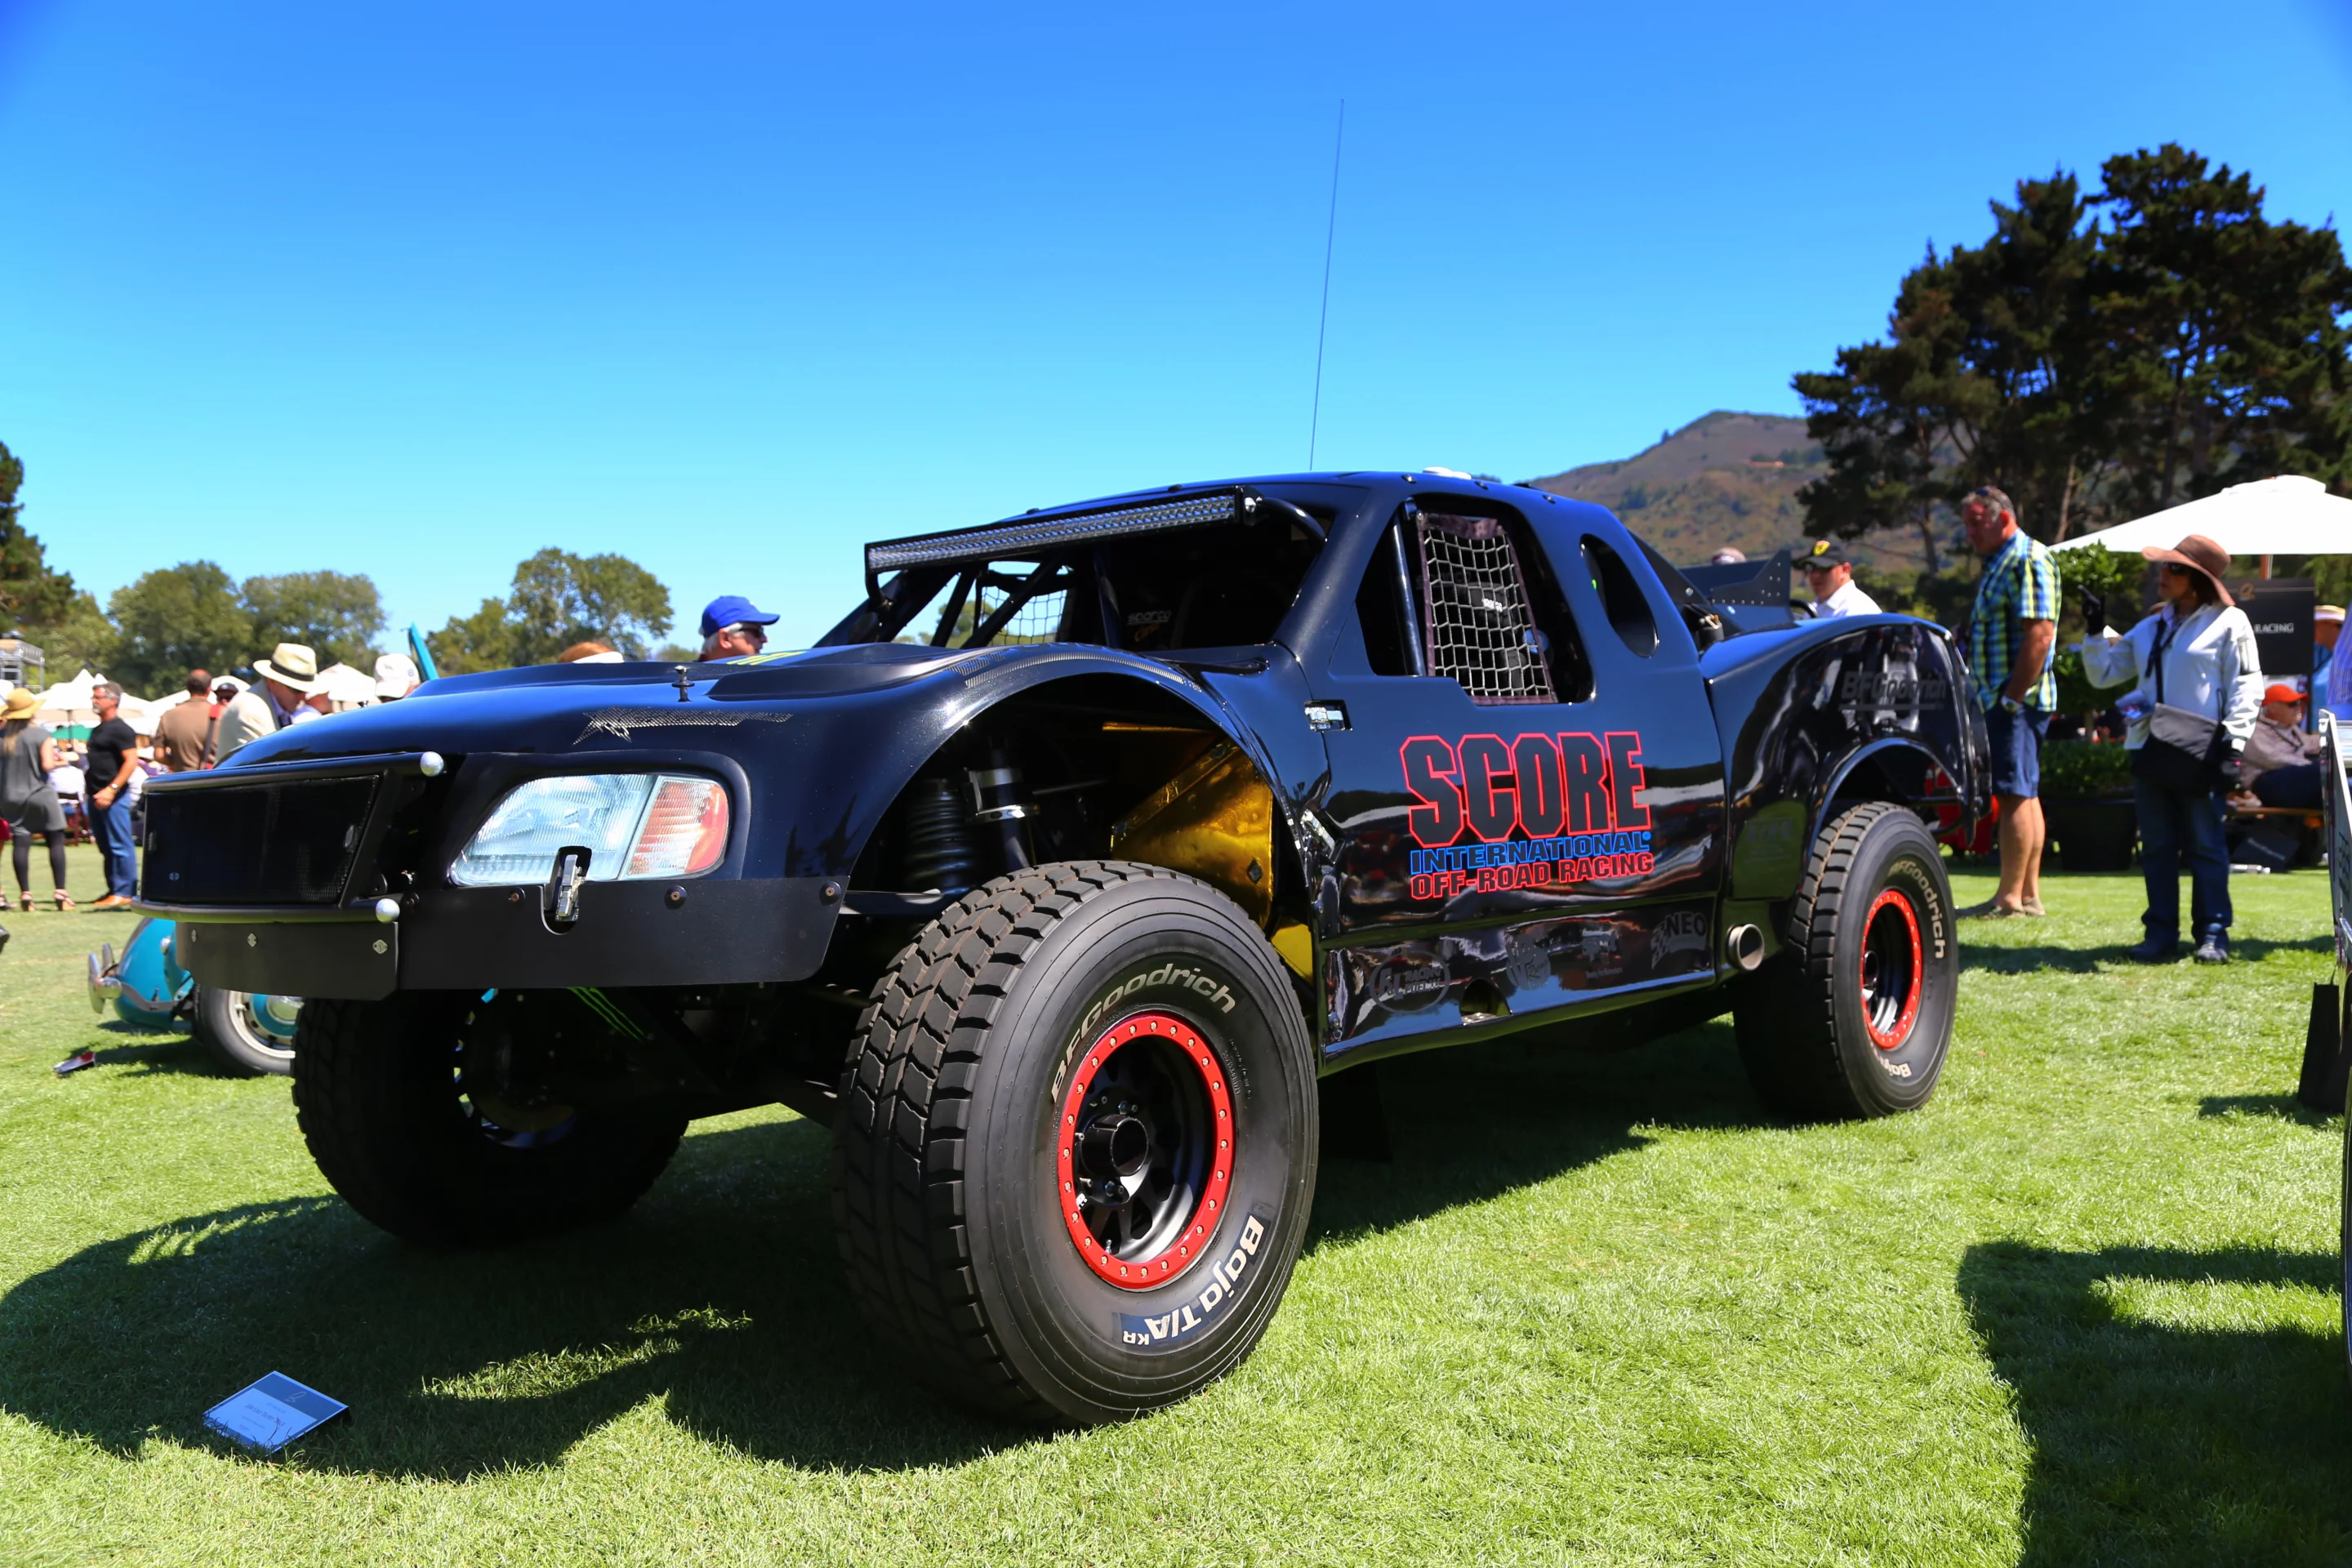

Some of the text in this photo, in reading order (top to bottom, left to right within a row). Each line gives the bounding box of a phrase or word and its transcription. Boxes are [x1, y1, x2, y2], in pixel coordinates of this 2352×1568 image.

[2254, 623, 2294, 634] RACING
[1841, 670, 1946, 700] BFGoodrich
[1400, 732, 1651, 849] SCORE
[1411, 852, 1655, 900] OFF-ROAD RACING
[1666, 912, 1707, 937] NEO
[1051, 963, 1236, 1103] BFGoodrich
[1199, 1214, 1264, 1313] Baja
[1123, 1330, 1150, 1346] KR
[1144, 1304, 1202, 1340] T/A
